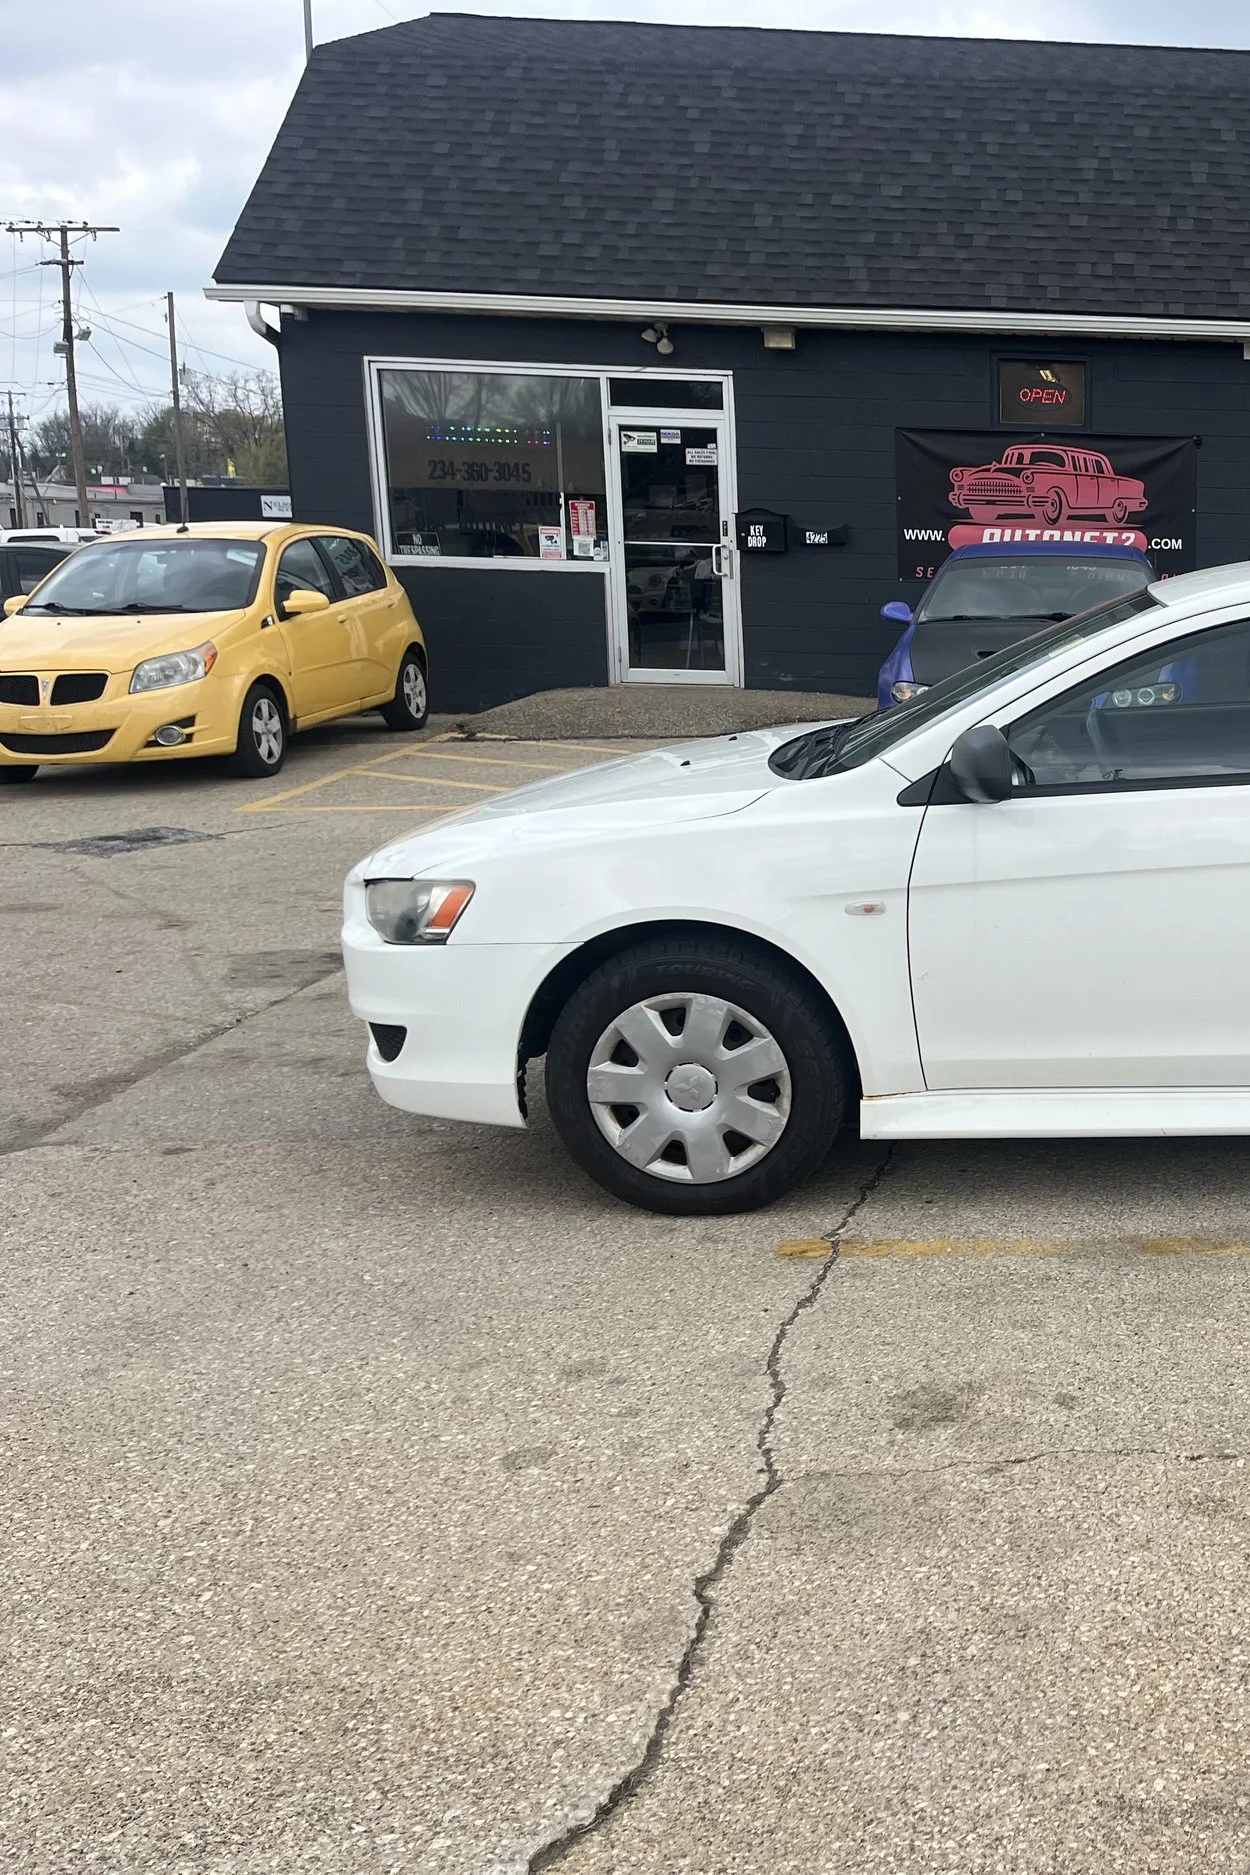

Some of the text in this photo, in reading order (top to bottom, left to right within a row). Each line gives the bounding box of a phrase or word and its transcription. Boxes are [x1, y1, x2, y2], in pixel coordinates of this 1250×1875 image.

[1019, 388, 1066, 404] OPEN
[427, 459, 532, 483] 234-360-3045
[749, 525, 764, 537] KEY
[412, 533, 422, 545] NO
[747, 536, 767, 548] DROP
[903, 528, 946, 542] WWW.
[1147, 538, 1183, 550] .COM
[398, 544, 441, 556] TRESPASSING
